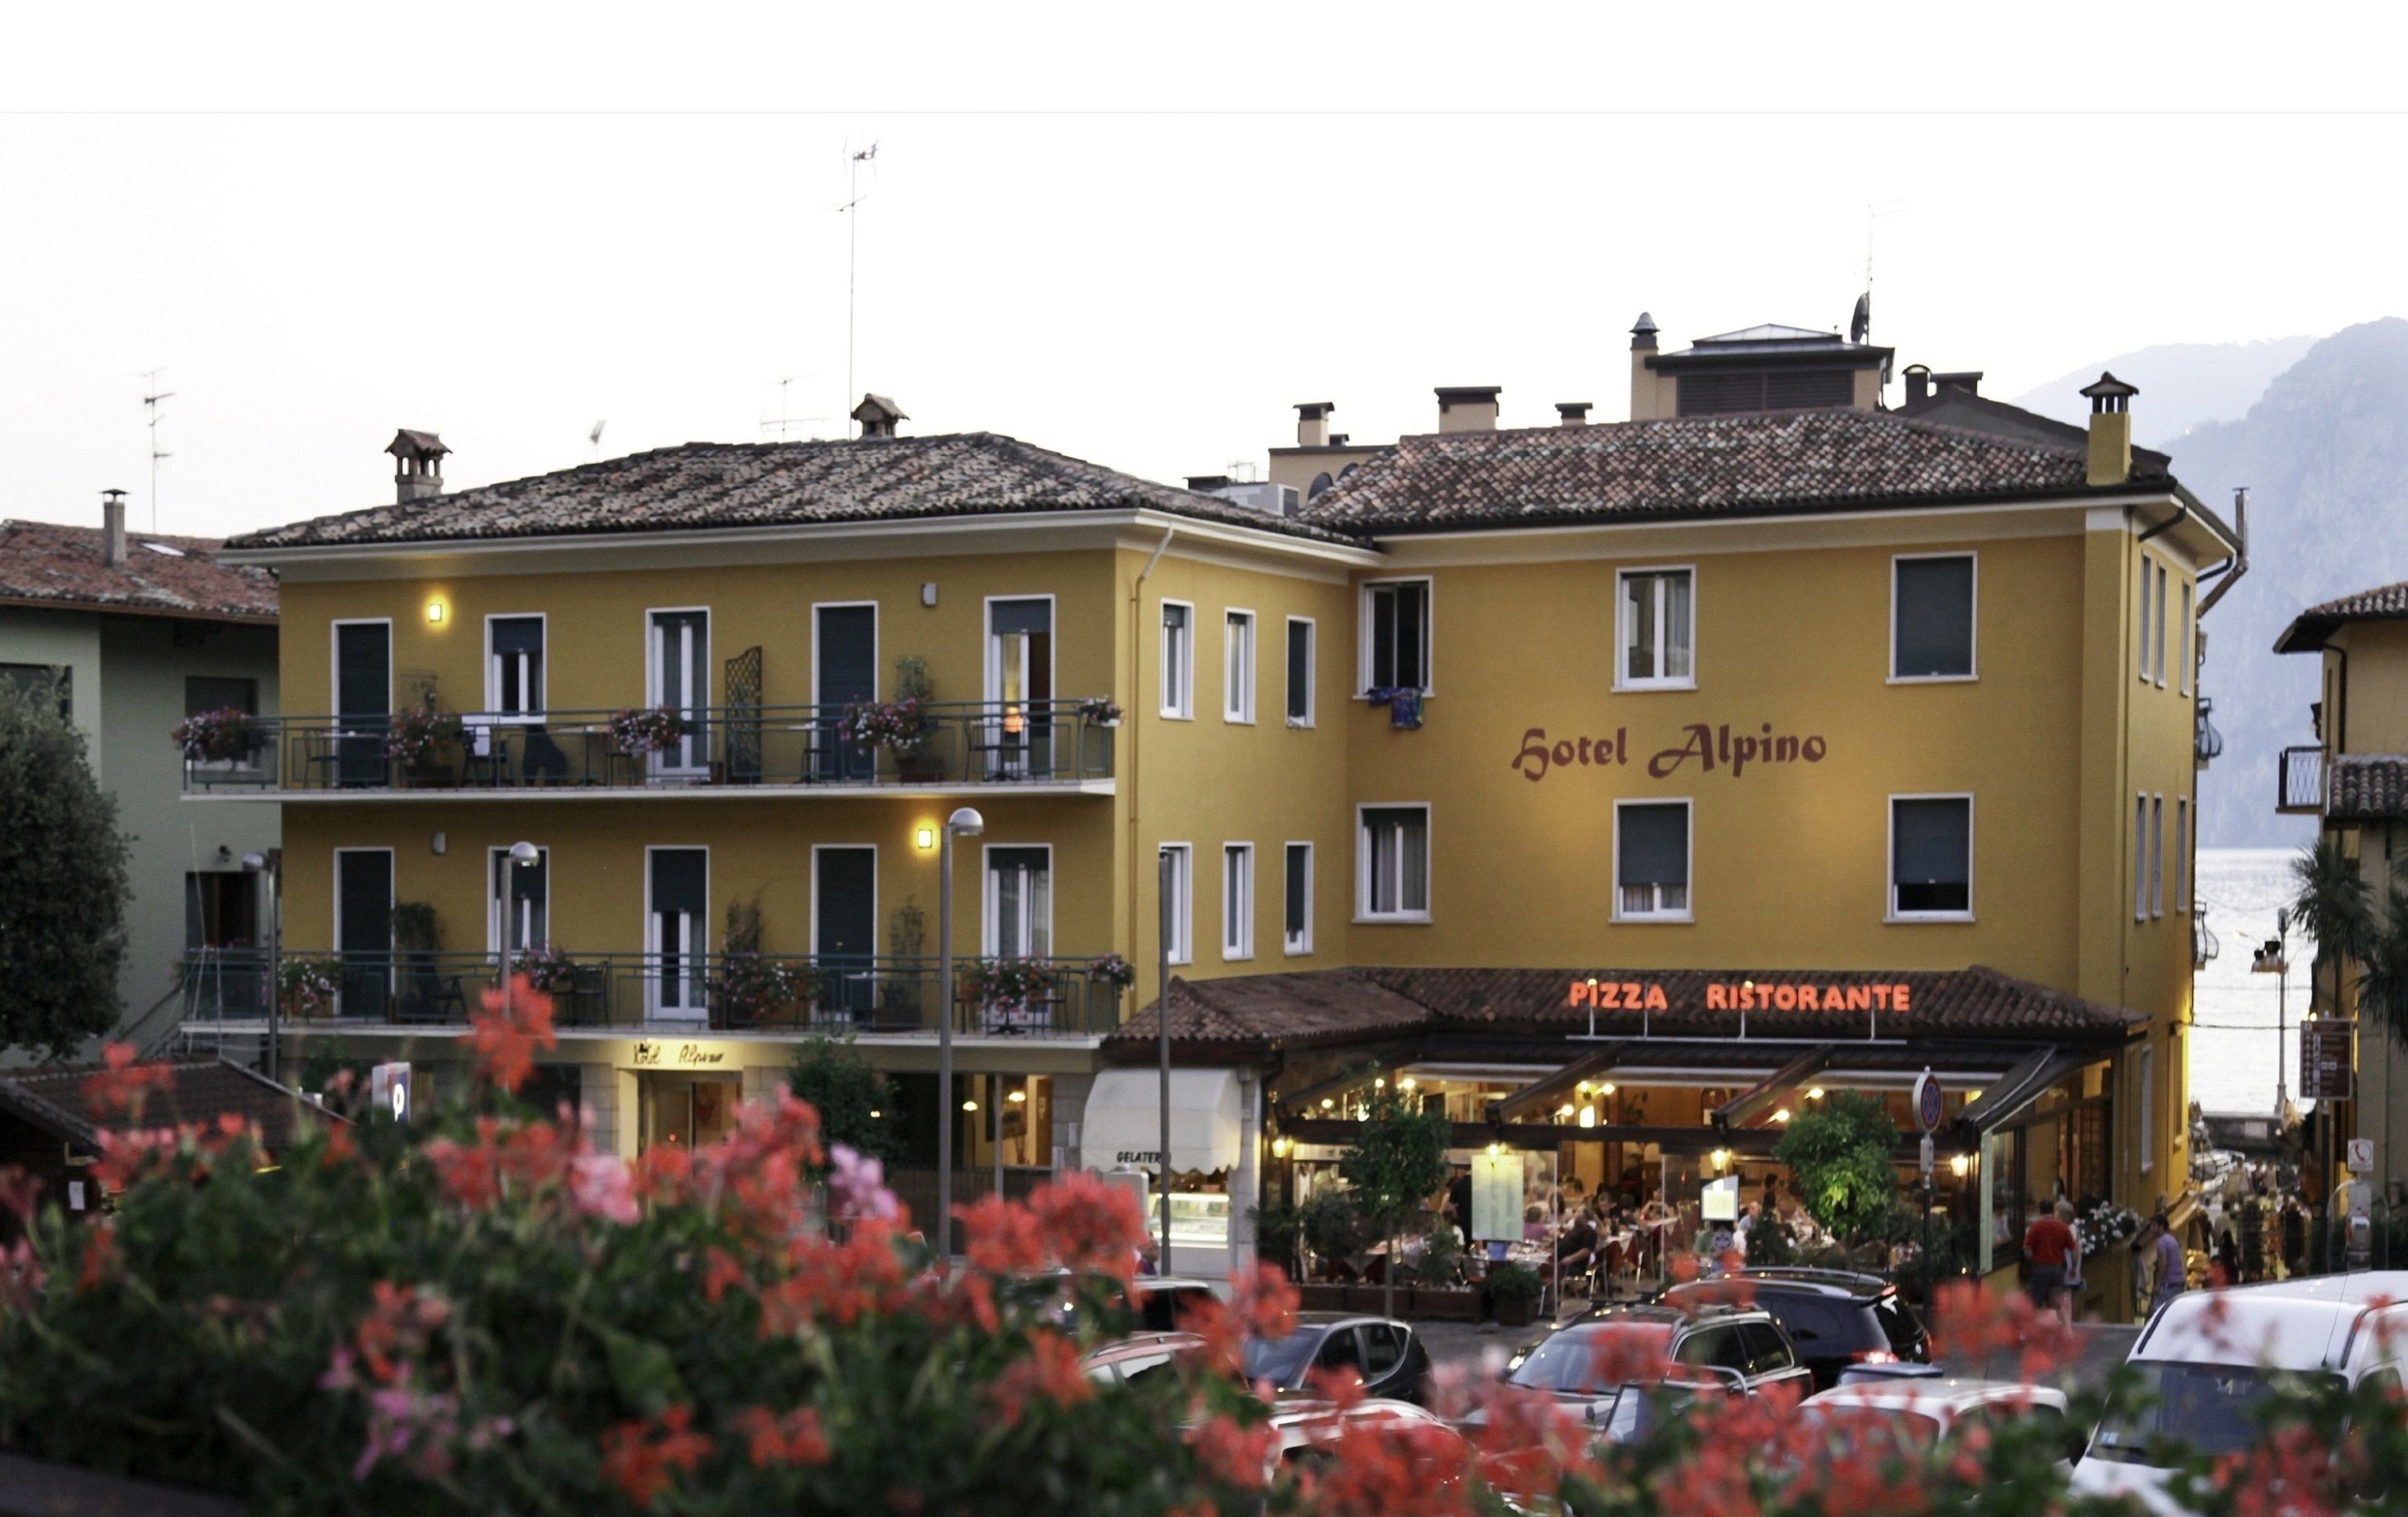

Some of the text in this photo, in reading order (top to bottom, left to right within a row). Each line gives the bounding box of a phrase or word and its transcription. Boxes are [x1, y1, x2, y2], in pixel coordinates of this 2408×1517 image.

[1511, 723, 1826, 782] Hotel Alpino
[1569, 982, 1911, 1011] PIZZA RISTORANTE
[1117, 1151, 1171, 1163] GELATER
